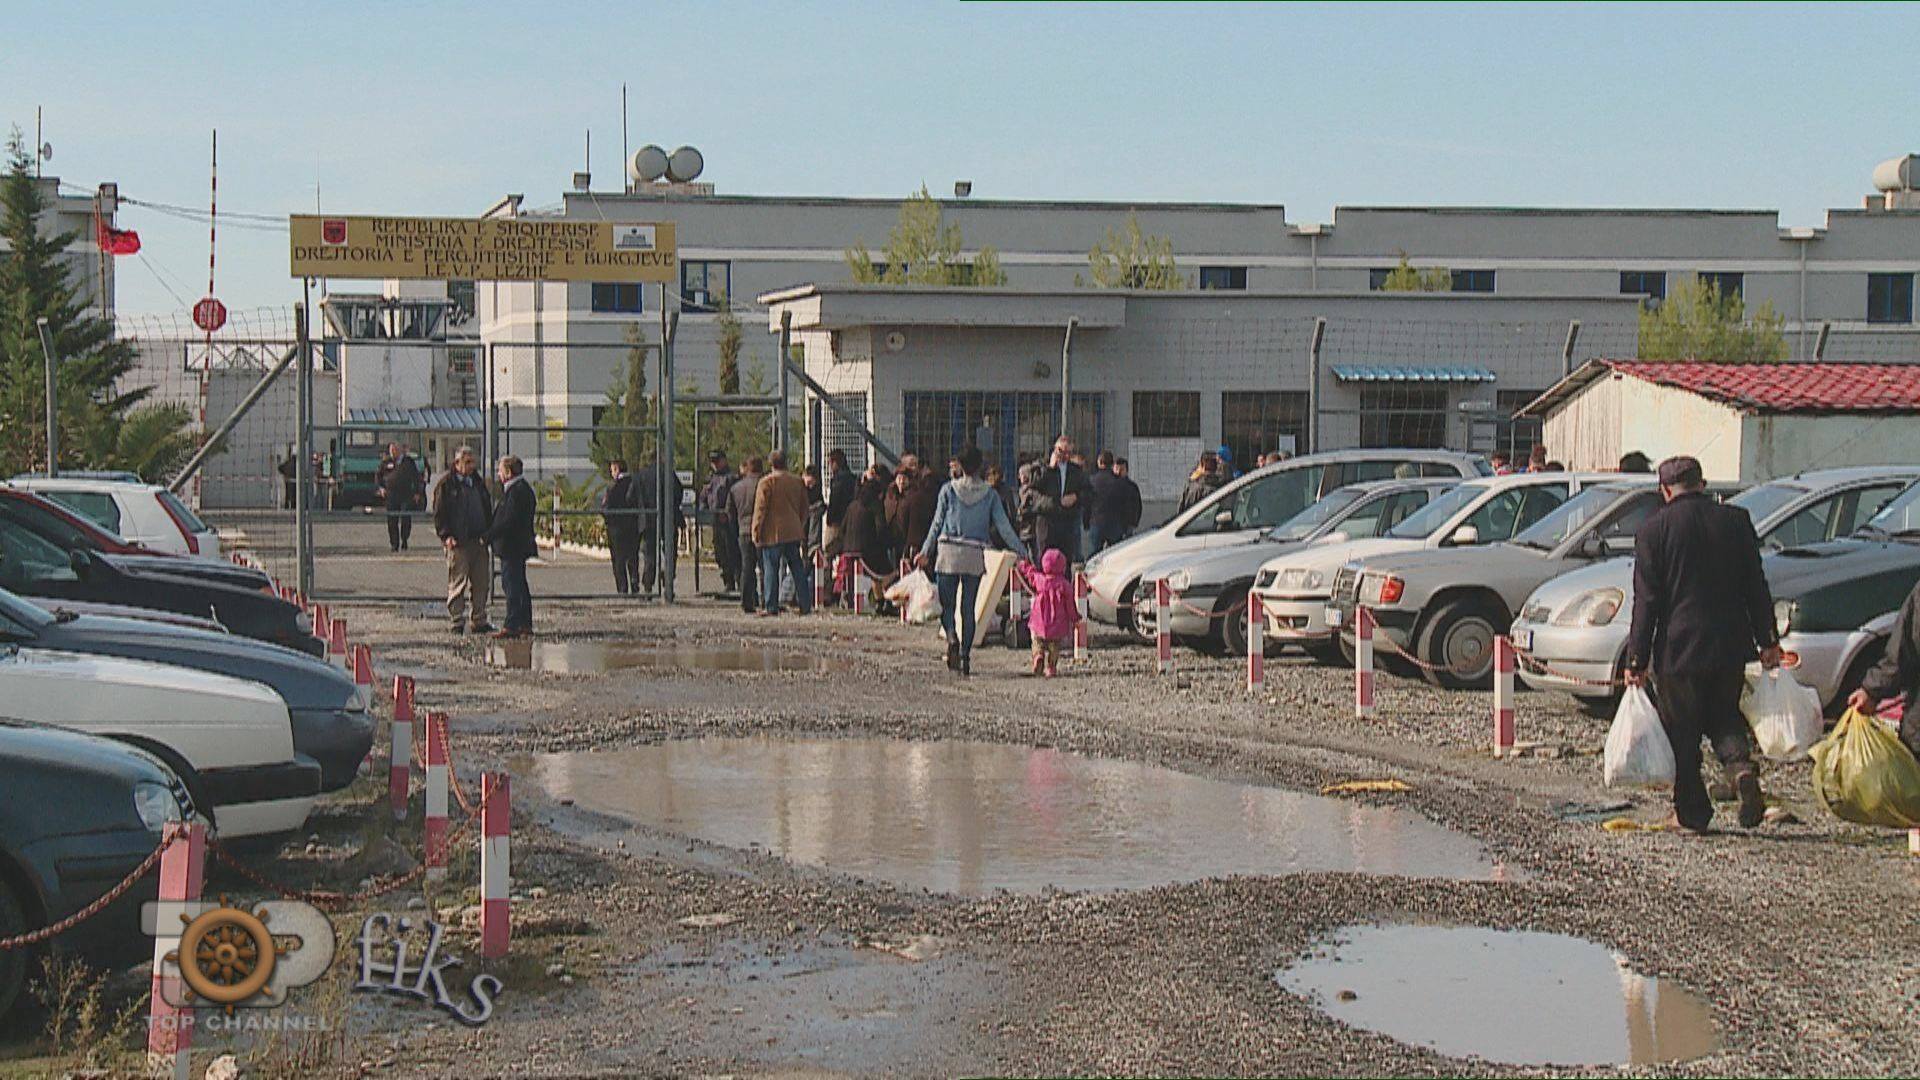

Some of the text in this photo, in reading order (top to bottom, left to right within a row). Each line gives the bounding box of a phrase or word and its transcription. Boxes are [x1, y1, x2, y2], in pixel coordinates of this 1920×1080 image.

[372, 218, 467, 235] REPUBLIKA
[477, 221, 487, 235] E
[376, 233, 464, 248] MINISTRIA
[474, 235, 484, 249] E
[294, 246, 394, 262] DREJTORIA
[404, 249, 414, 262] E
[565, 251, 575, 265] E
[584, 251, 673, 267] BURGJEVE
[494, 264, 549, 278] LEZHE
